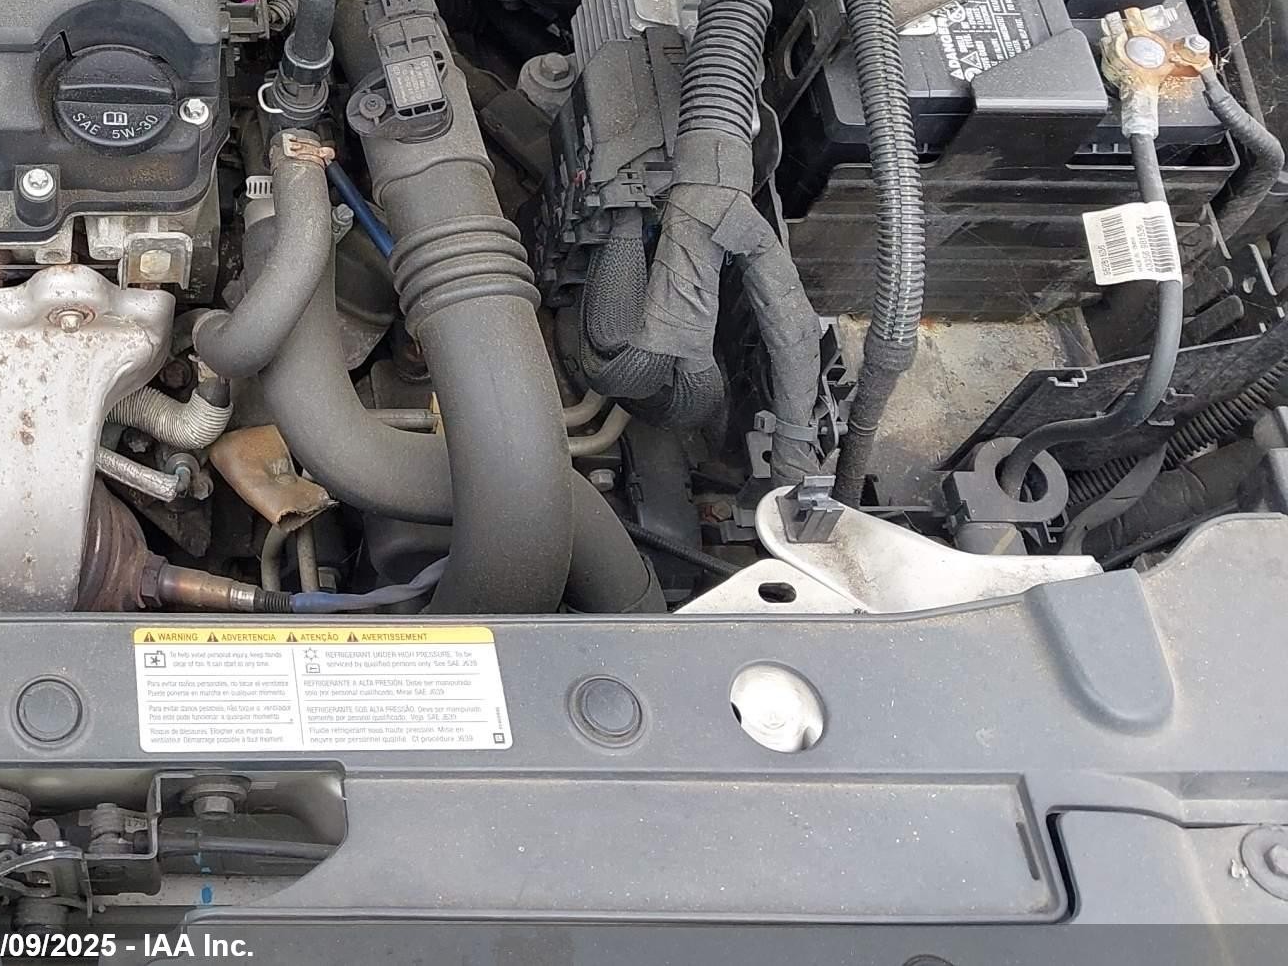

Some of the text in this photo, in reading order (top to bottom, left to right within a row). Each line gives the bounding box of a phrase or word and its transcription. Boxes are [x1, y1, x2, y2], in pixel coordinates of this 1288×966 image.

[73, 113, 158, 139] SAE 5W-30
[158, 633, 198, 641] WARNING
[300, 632, 339, 642] ATENÇÃO
[361, 633, 428, 641] AVERTISSEMENT
